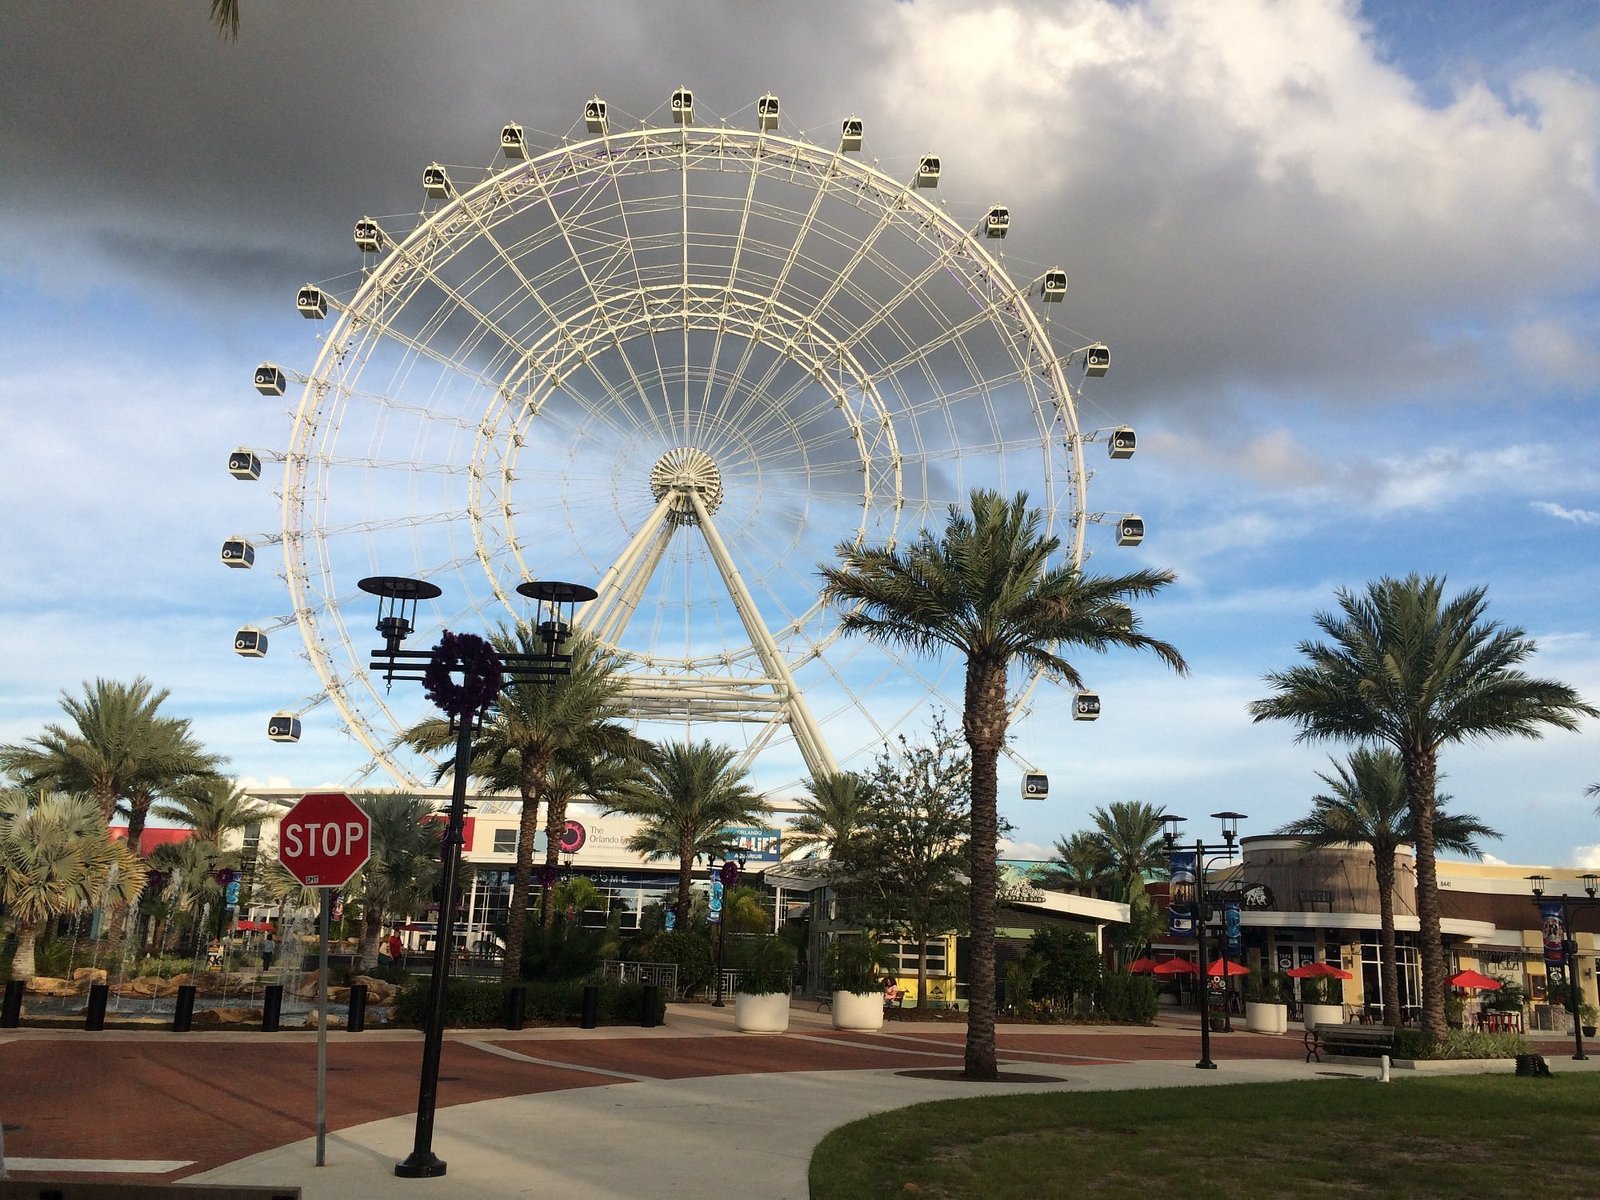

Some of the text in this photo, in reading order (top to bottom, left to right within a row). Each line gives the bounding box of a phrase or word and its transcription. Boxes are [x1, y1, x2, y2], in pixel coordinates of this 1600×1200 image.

[590, 826, 604, 834] The
[285, 822, 364, 857] STOP
[589, 835, 619, 844] Orlando
